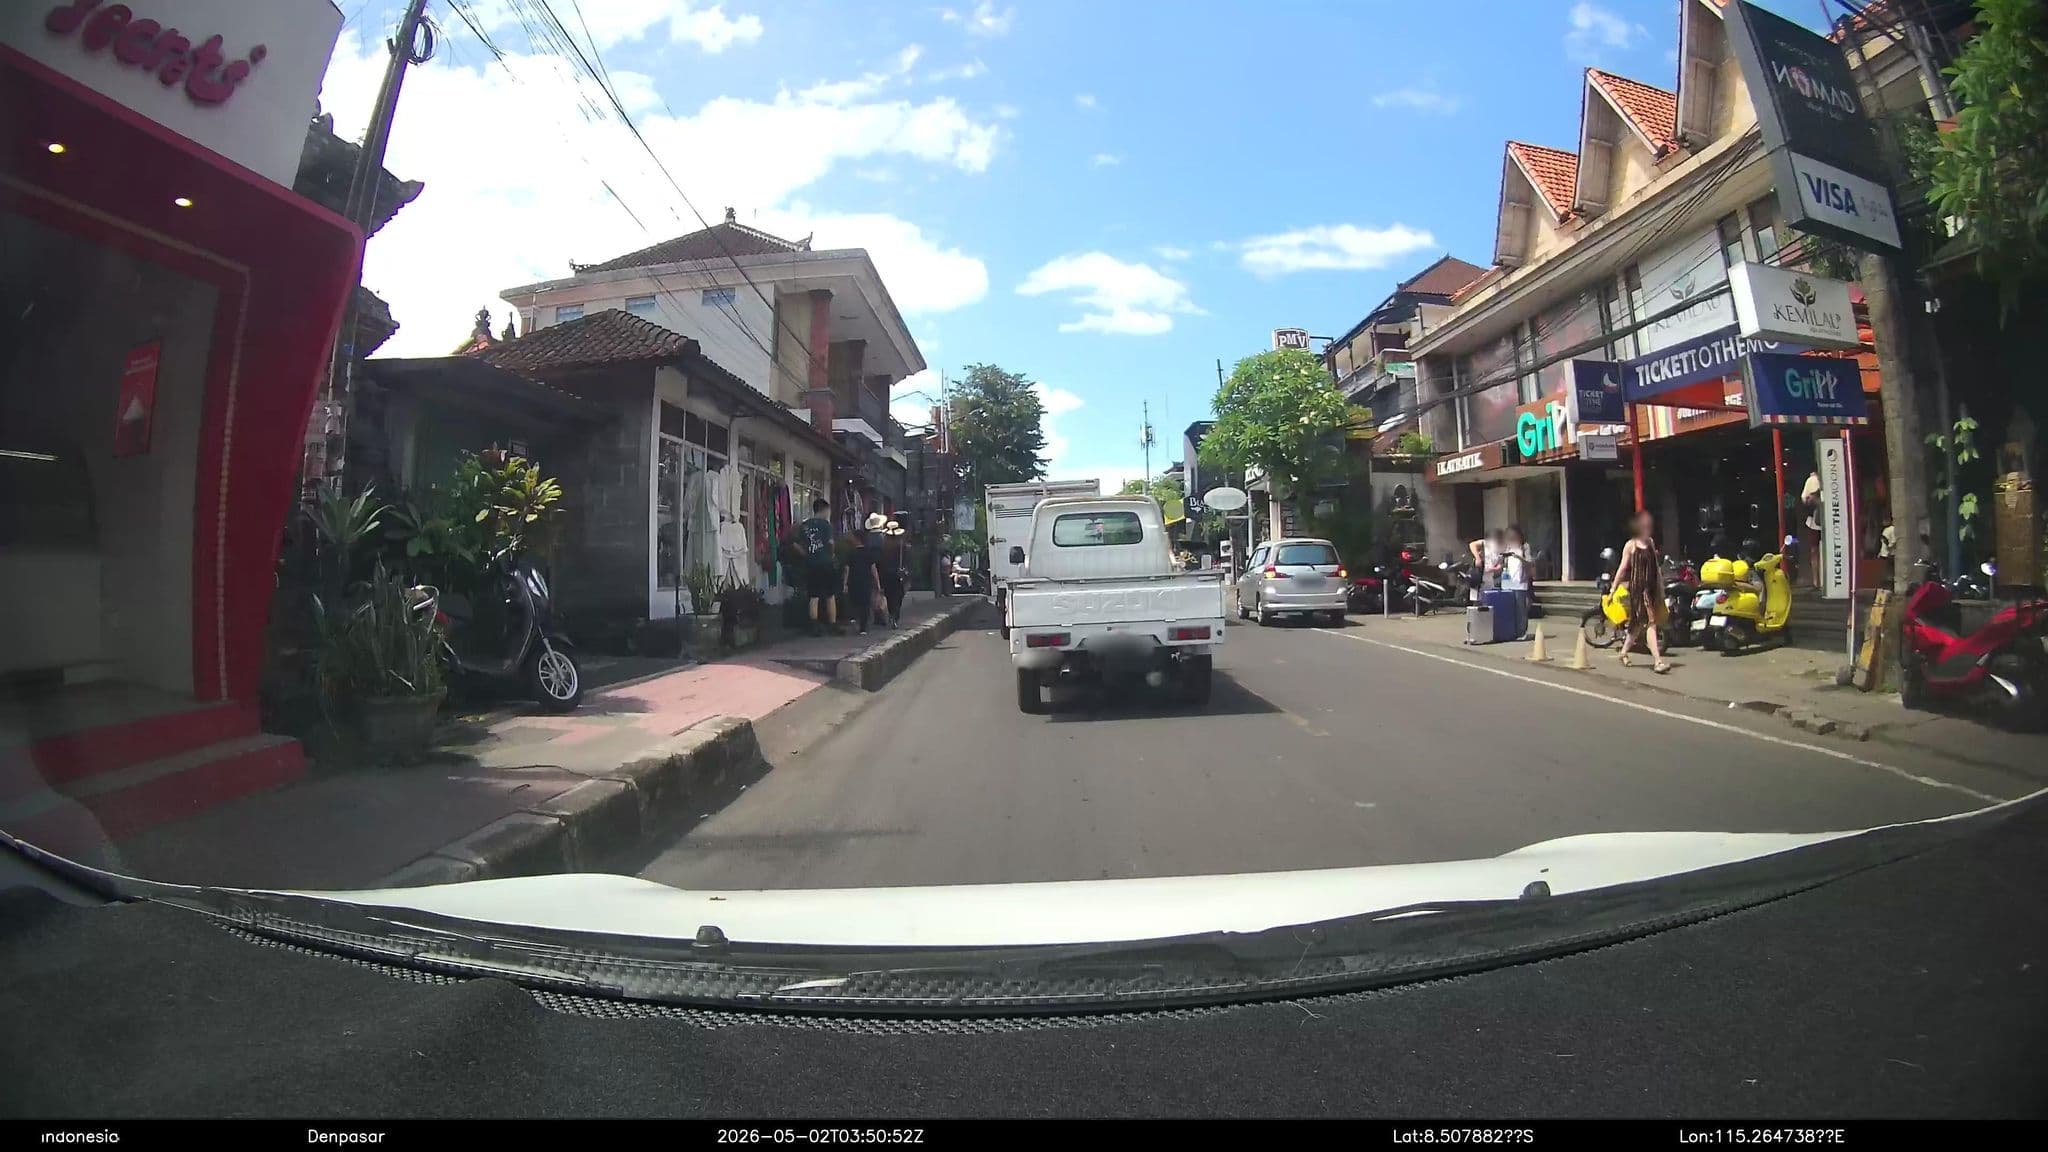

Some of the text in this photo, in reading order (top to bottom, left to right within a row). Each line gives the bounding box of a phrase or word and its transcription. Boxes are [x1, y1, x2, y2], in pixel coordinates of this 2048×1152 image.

[1800, 171, 1860, 217] VISA
[1773, 303, 1841, 330] KEMILAU
[1278, 333, 1306, 348] PMV
